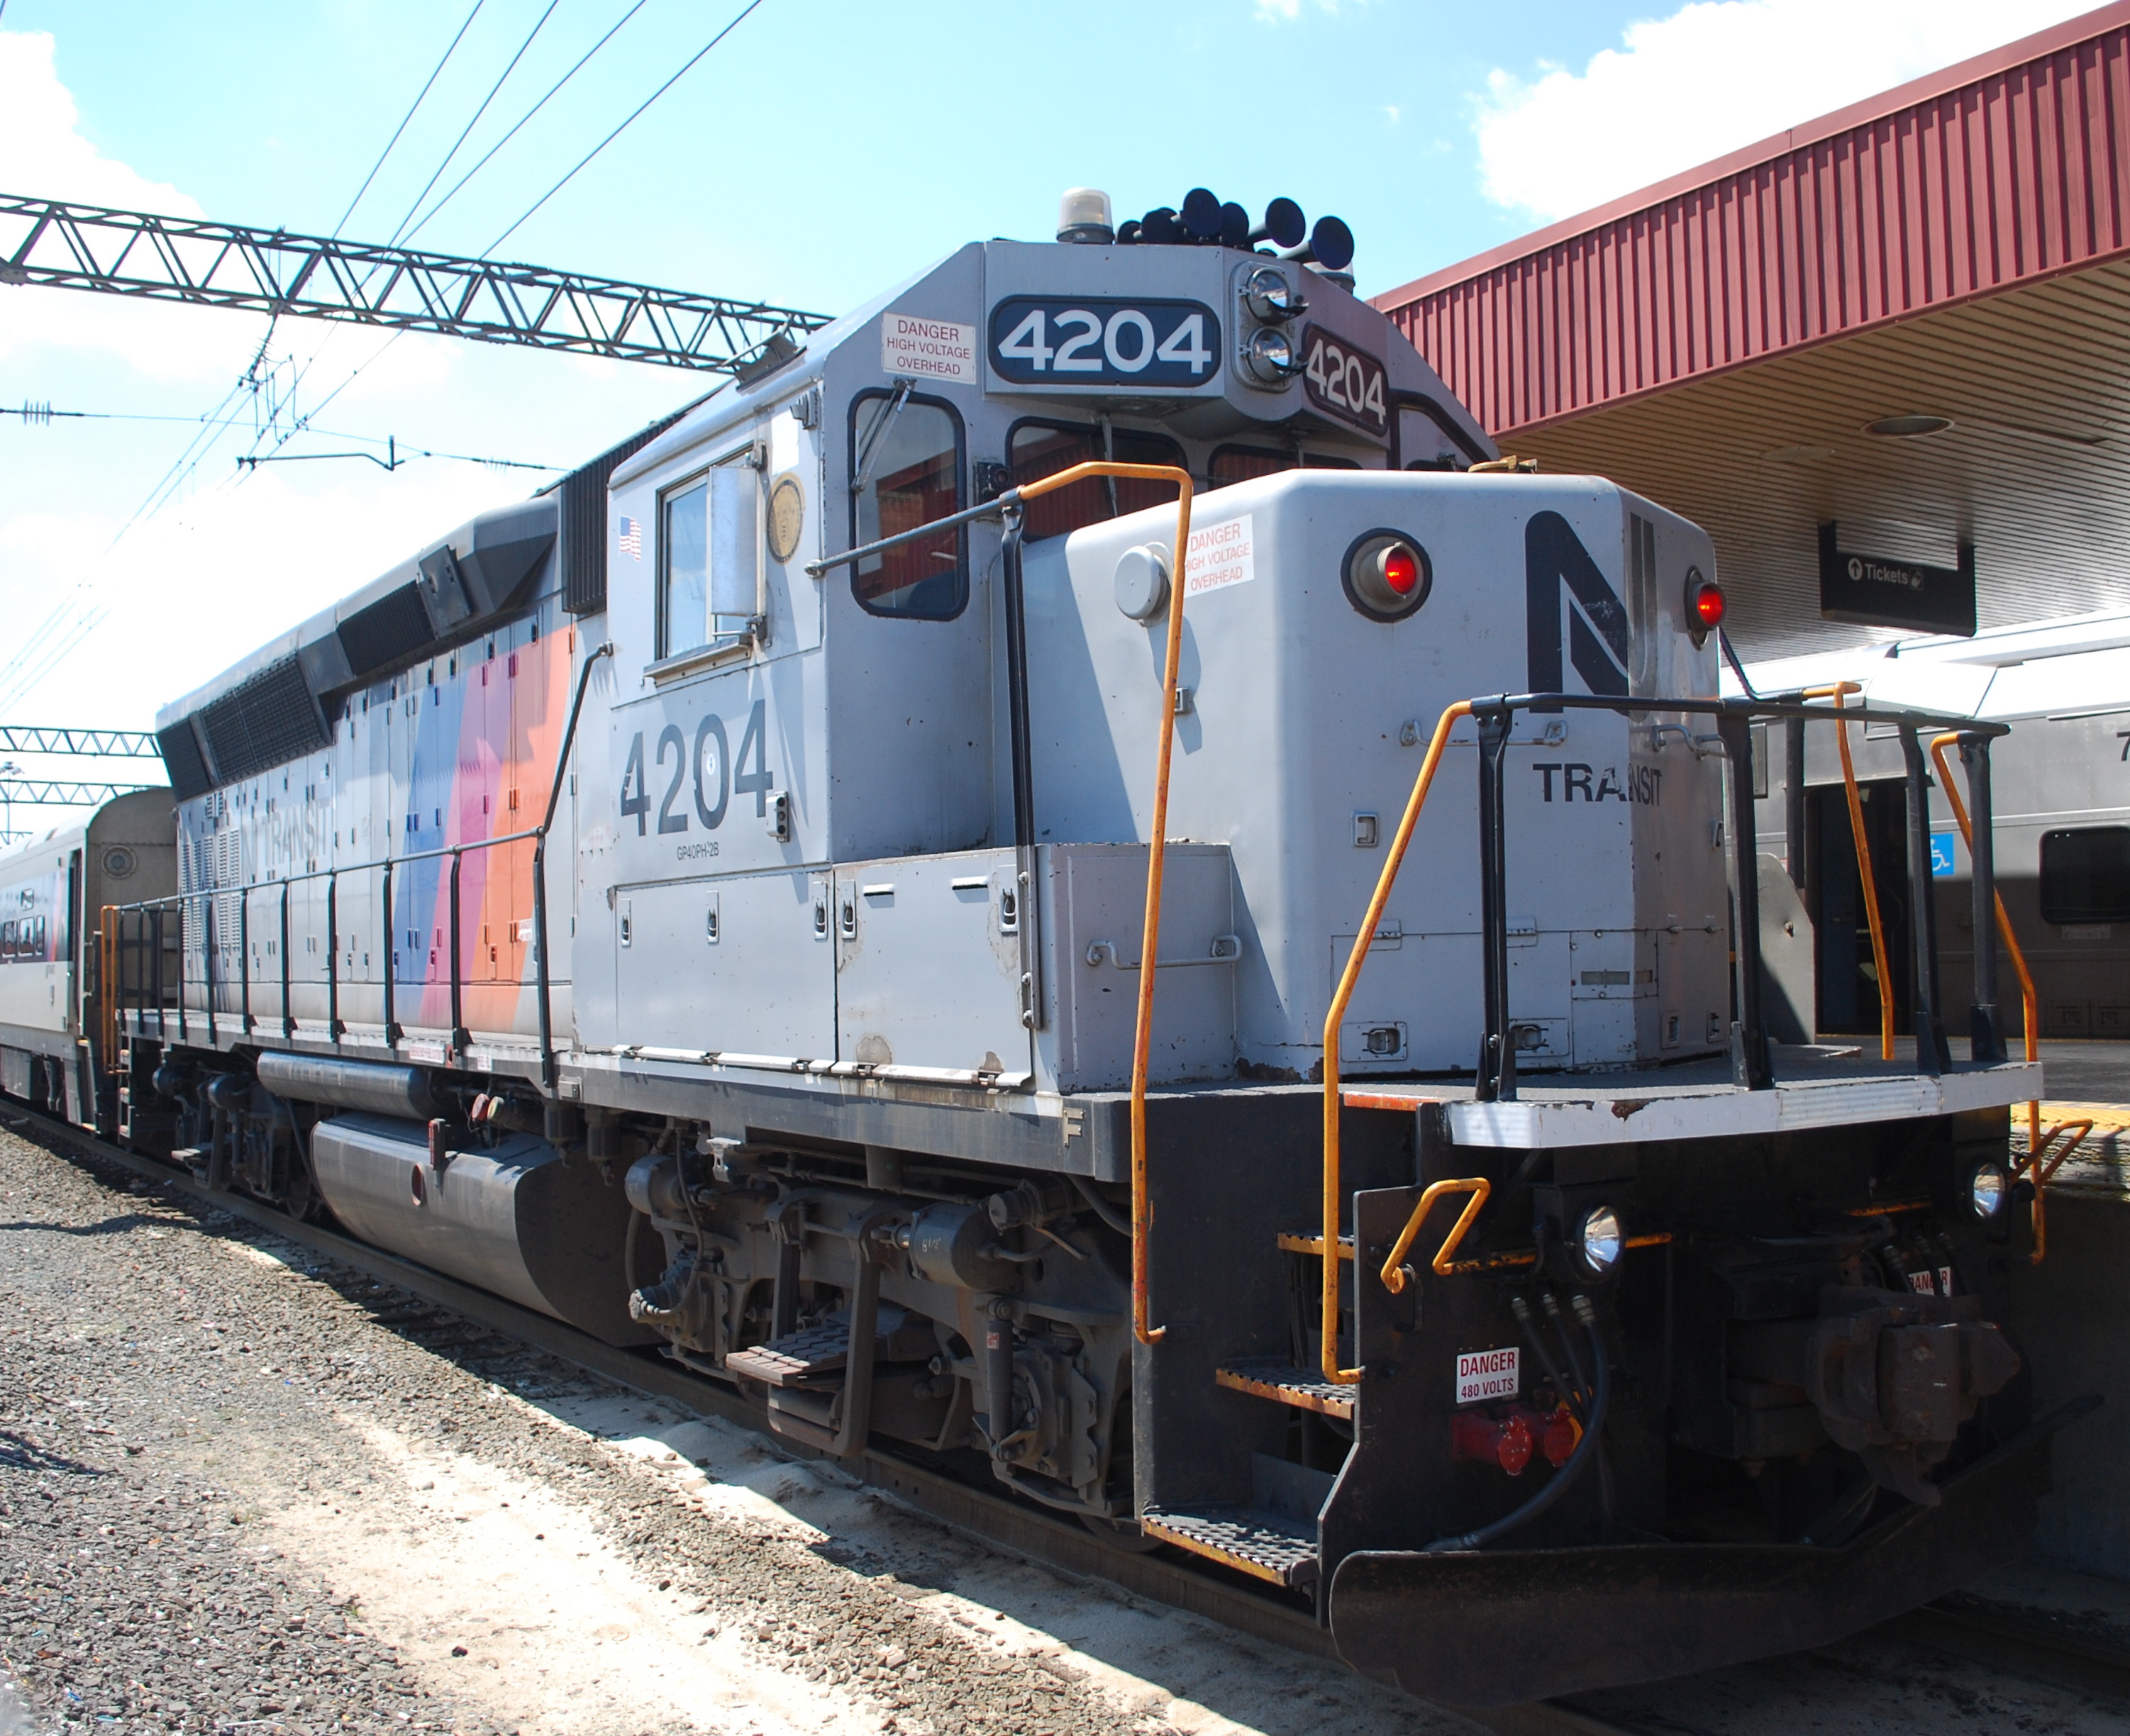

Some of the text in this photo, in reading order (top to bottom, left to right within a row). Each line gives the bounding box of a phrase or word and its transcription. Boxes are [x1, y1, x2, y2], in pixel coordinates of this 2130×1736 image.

[898, 319, 959, 342] DANGER
[998, 309, 1211, 374] 4204
[887, 337, 970, 360] HIGH VOLTAGE
[897, 355, 960, 375] OVERHEAD
[1307, 338, 1387, 425] 4204
[1190, 523, 1241, 552] DANGER
[1208, 542, 1250, 565] VOLTAGE
[1190, 566, 1243, 591] OVERHEAD
[1865, 562, 1909, 585] Tickets
[621, 699, 774, 837] 4204
[1532, 763, 1663, 806] TRANSIT
[262, 796, 331, 868] TRANSIT
[676, 841, 720, 861] GP40PH-2B
[1062, 1107, 1084, 1147] F
[1909, 1270, 1948, 1291] ANR
[1460, 1351, 1515, 1377] DANGER
[1461, 1378, 1514, 1398] 480 VOLTS
